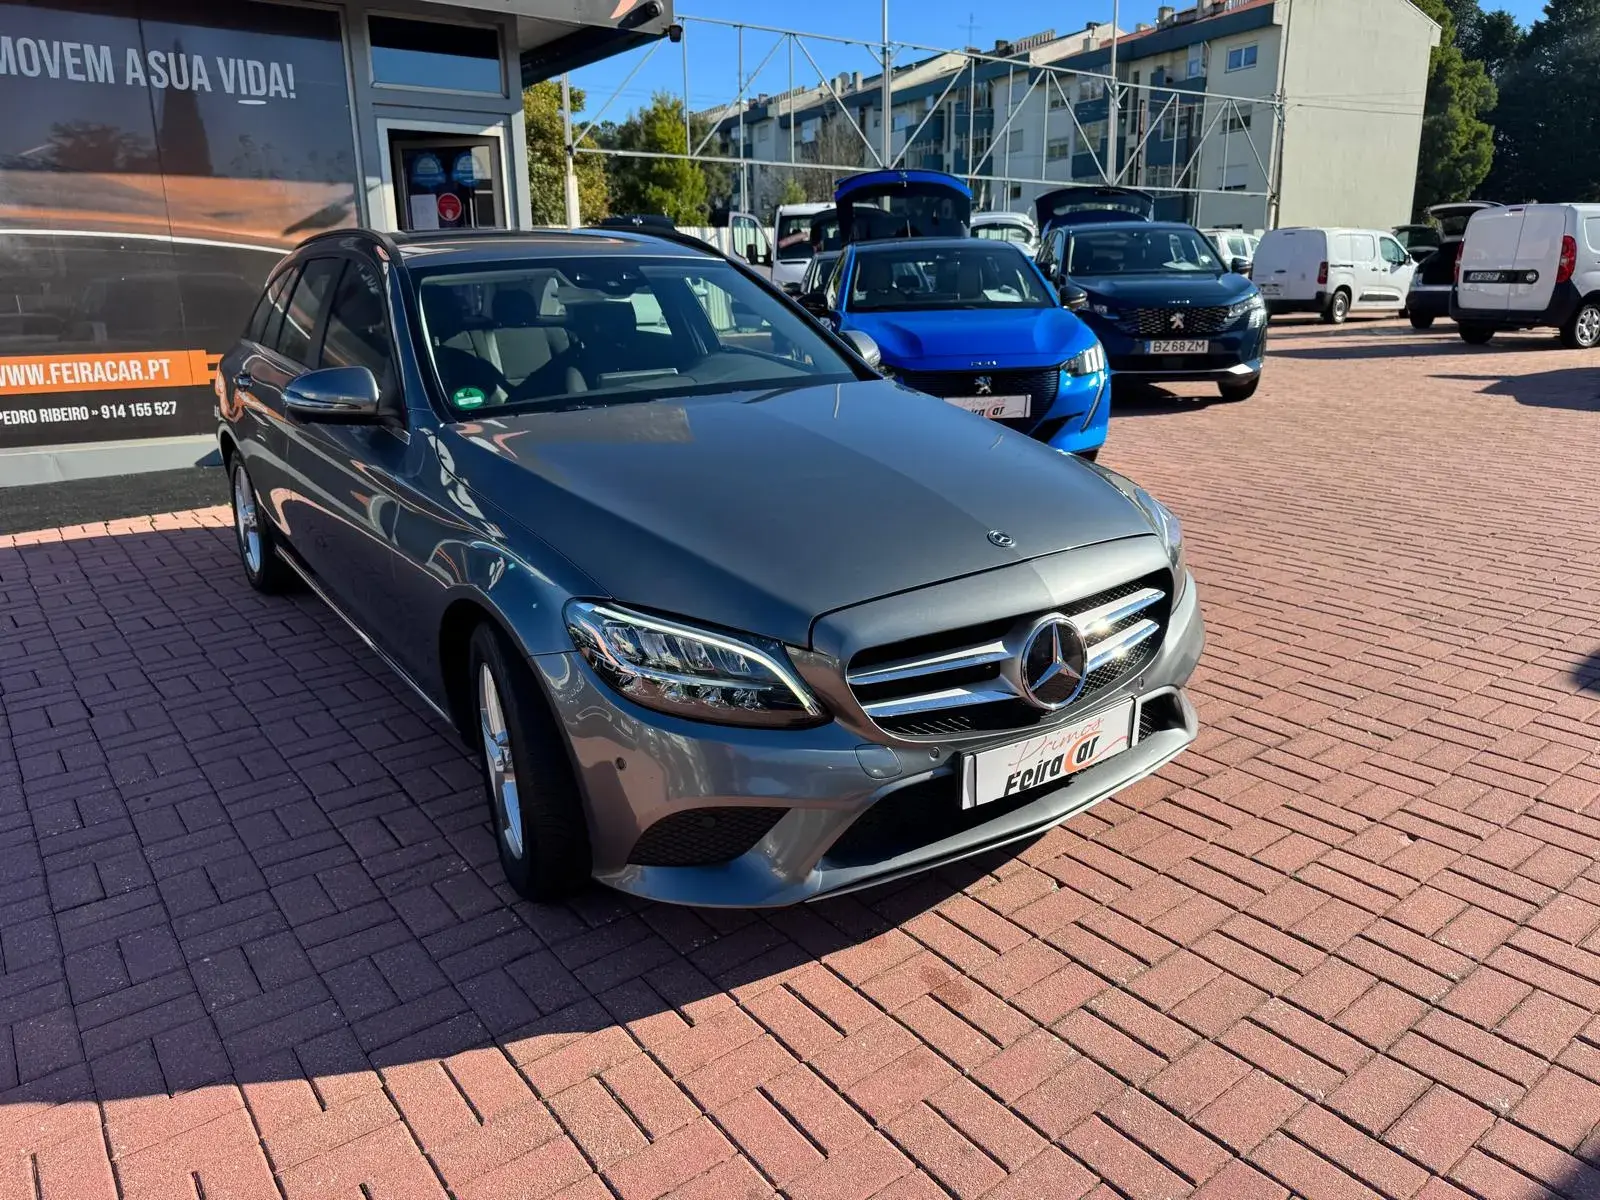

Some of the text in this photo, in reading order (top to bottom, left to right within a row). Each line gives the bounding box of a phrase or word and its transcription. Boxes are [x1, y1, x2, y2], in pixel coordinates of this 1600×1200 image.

[216, 56, 297, 99] VIDA!
[0, 358, 170, 387] WW.FEIRACAR.PT
[40, 406, 89, 423] RIBEIRO
[101, 404, 126, 419] 914
[129, 402, 151, 417] 155
[155, 401, 177, 416] 527
